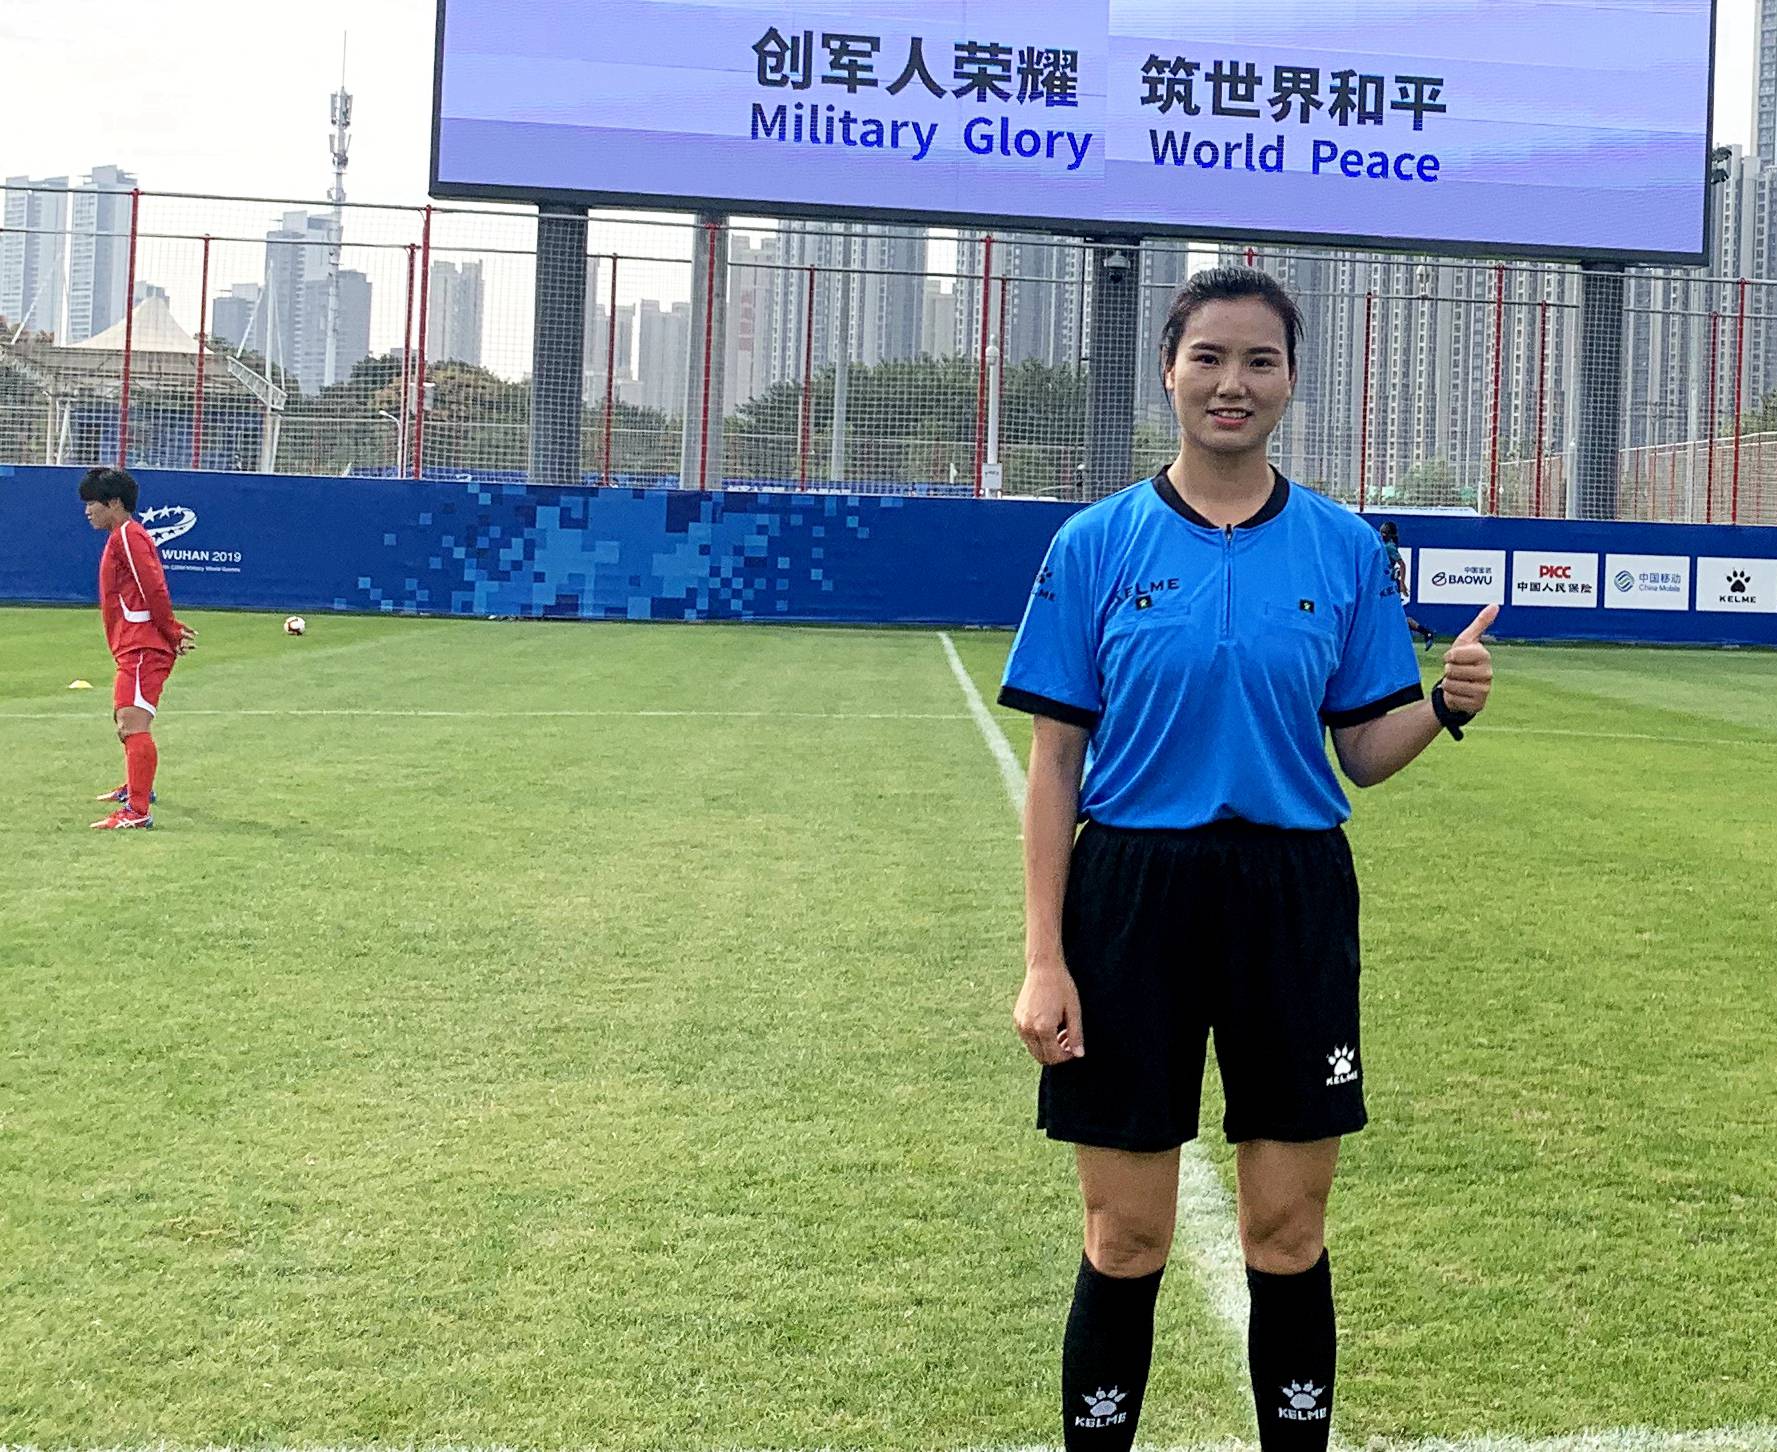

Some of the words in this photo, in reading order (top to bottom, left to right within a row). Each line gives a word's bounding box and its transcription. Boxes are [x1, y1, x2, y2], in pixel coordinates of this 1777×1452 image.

[752, 26, 1078, 107] 创军人荣耀
[1141, 54, 1446, 131] 筑世界和平
[751, 102, 938, 160] Military
[964, 116, 1092, 170] Glory
[1149, 129, 1284, 172] World
[1312, 139, 1440, 182] Peace
[161, 549, 209, 561] WUHAN
[212, 551, 242, 562] 2019
[1539, 565, 1571, 579] PICC
[1639, 573, 1681, 584] 中国移动
[1448, 575, 1493, 585] BAOWU
[1517, 581, 1592, 594] 中国人民保险
[1719, 595, 1757, 603] KELME
[1075, 1411, 1127, 1428] KELME
[1278, 1407, 1327, 1420] KELME
